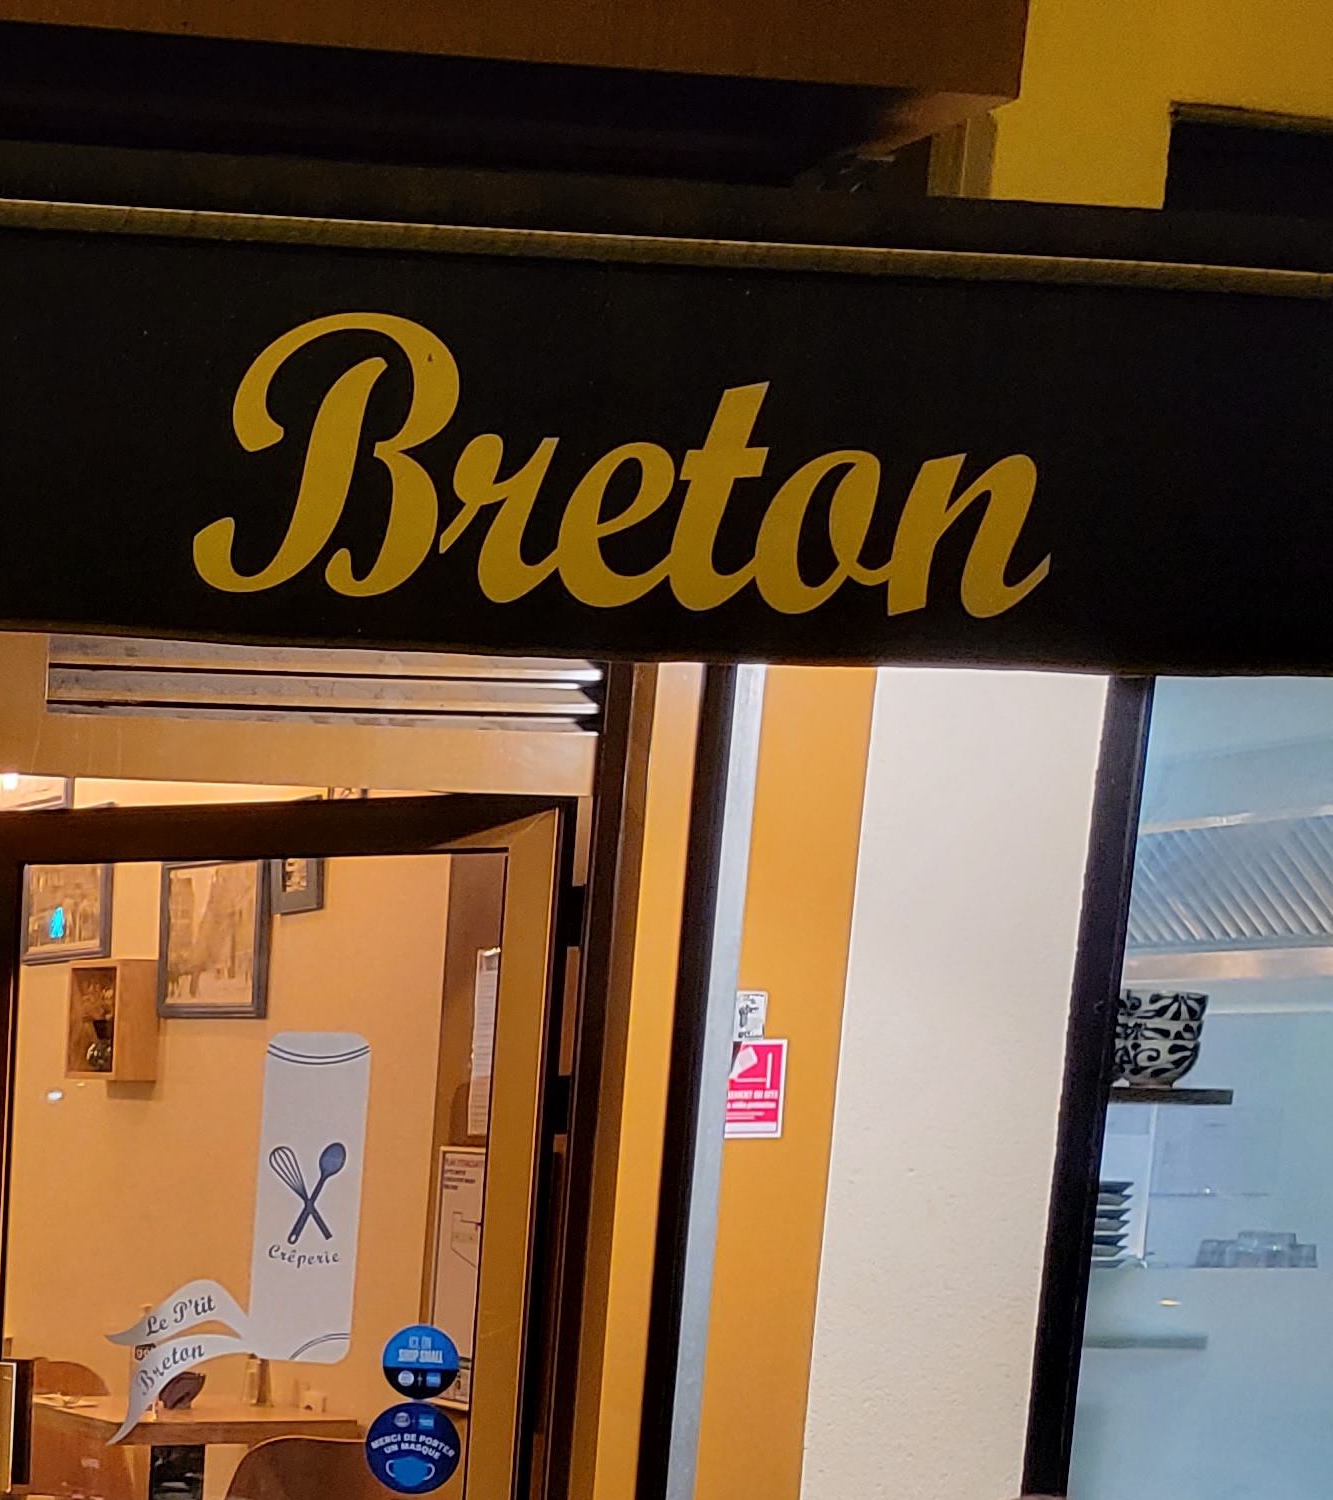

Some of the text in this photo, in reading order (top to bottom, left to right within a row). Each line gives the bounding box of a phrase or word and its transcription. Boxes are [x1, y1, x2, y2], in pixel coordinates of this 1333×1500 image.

[193, 312, 1051, 618] Breton
[268, 1244, 340, 1269] Crêperie
[146, 1294, 217, 1337] Le P'tit
[136, 1344, 205, 1396] Breton
[370, 1433, 455, 1457] MERCI DE PORTER
[383, 1442, 441, 1460] UN MASQUE
